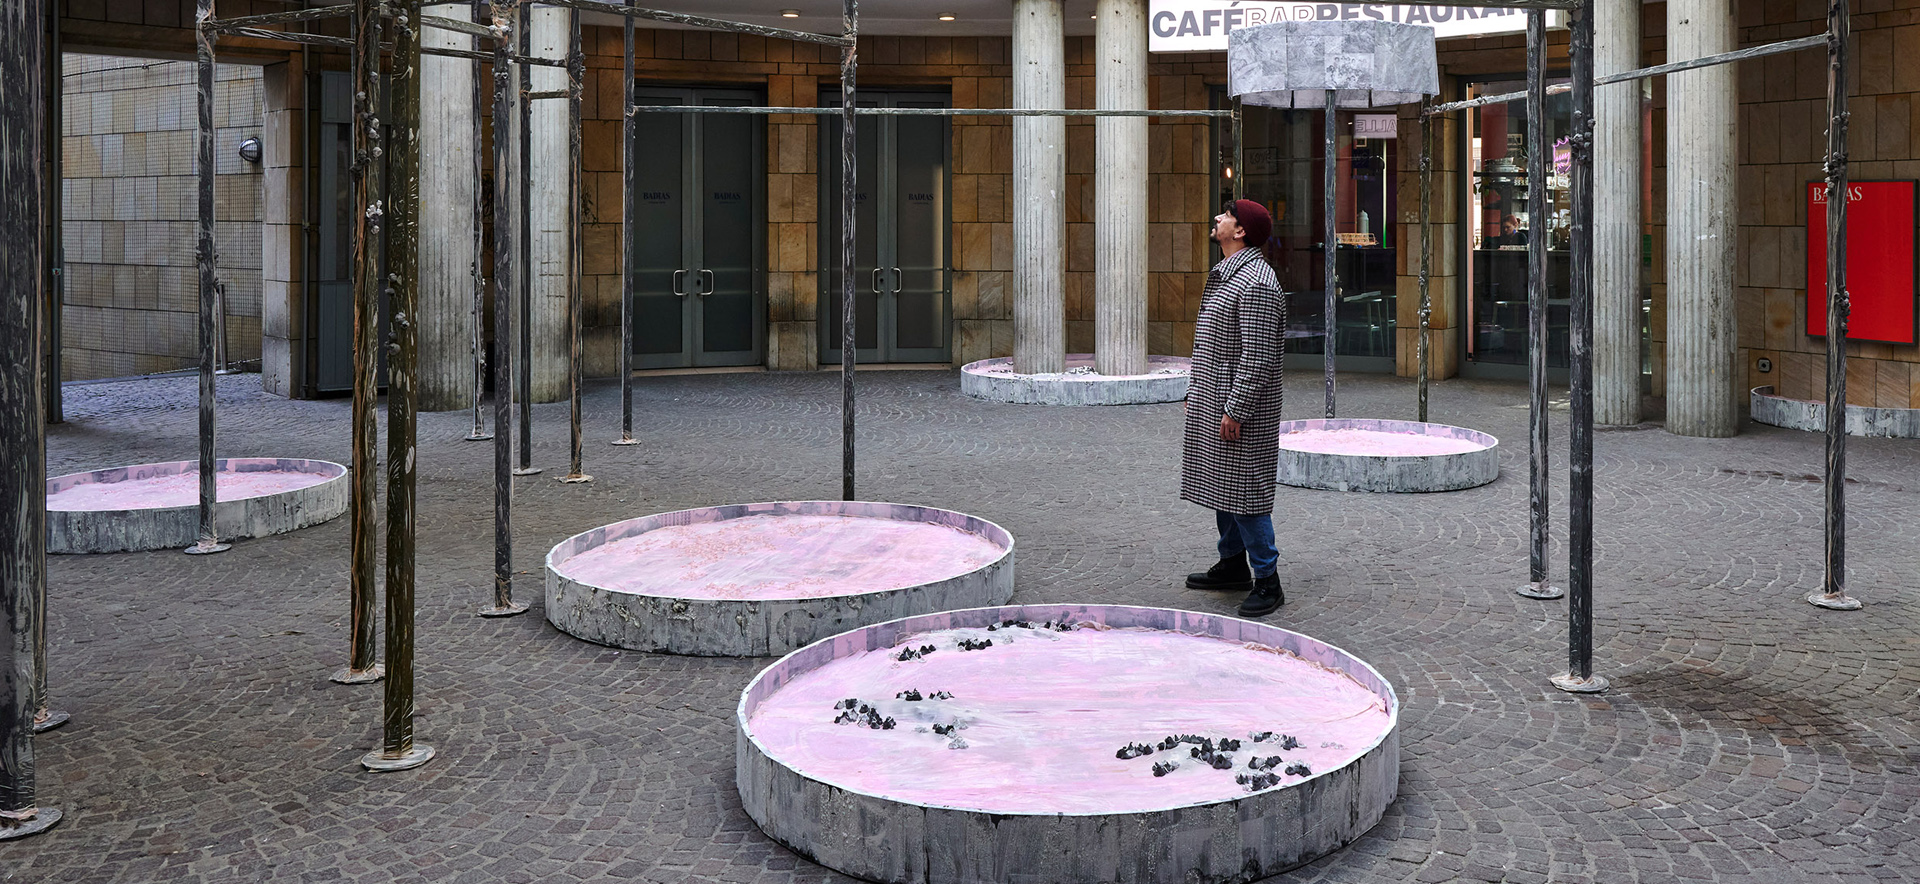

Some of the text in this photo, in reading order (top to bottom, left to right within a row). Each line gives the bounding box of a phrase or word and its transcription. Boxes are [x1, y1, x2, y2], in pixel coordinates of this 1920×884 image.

[643, 192, 671, 200] BADIAS
[714, 192, 741, 200] BADIAS
[908, 193, 934, 201] BADIAS
